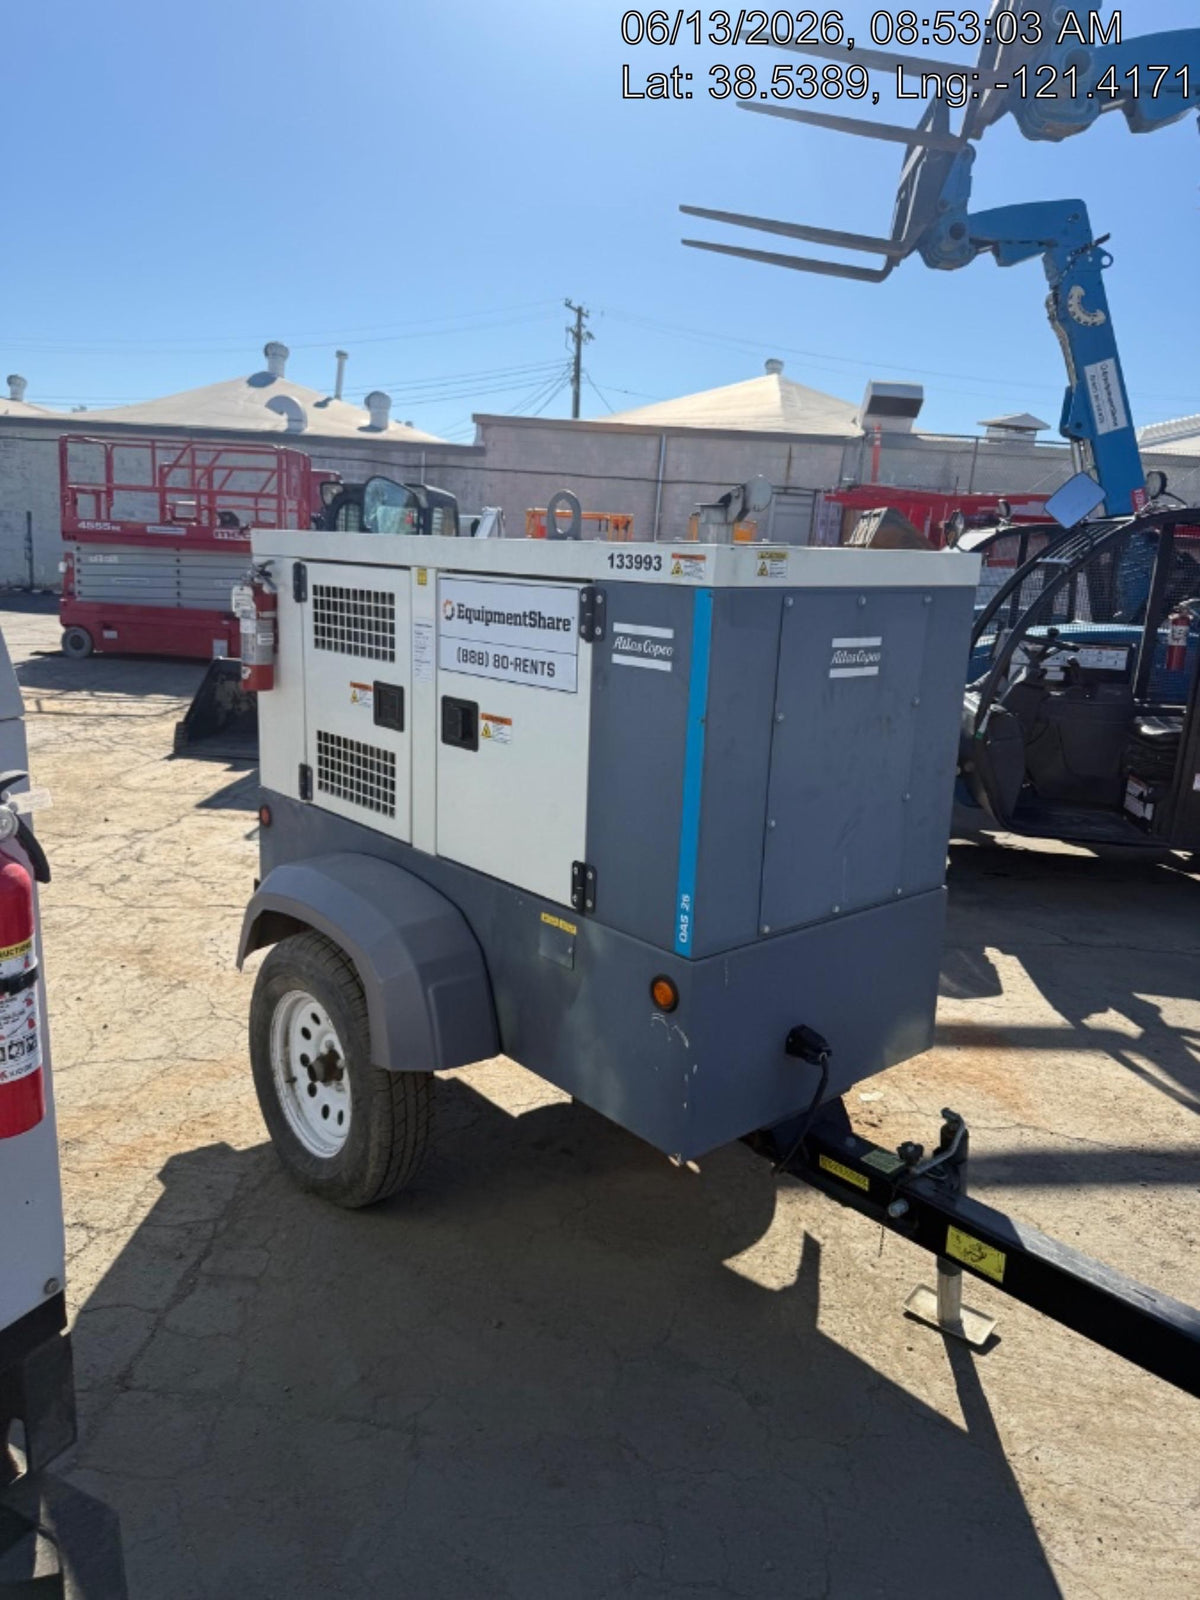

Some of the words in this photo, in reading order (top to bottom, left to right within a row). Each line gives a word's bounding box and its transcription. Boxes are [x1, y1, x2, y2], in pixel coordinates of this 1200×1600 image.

[607, 552, 663, 572] 133993
[456, 602, 572, 632] EquipmentShare
[612, 635, 642, 653] Atlas
[643, 640, 673, 657] Copco
[456, 646, 489, 668] (888)
[493, 653, 556, 677] 80-RENTS
